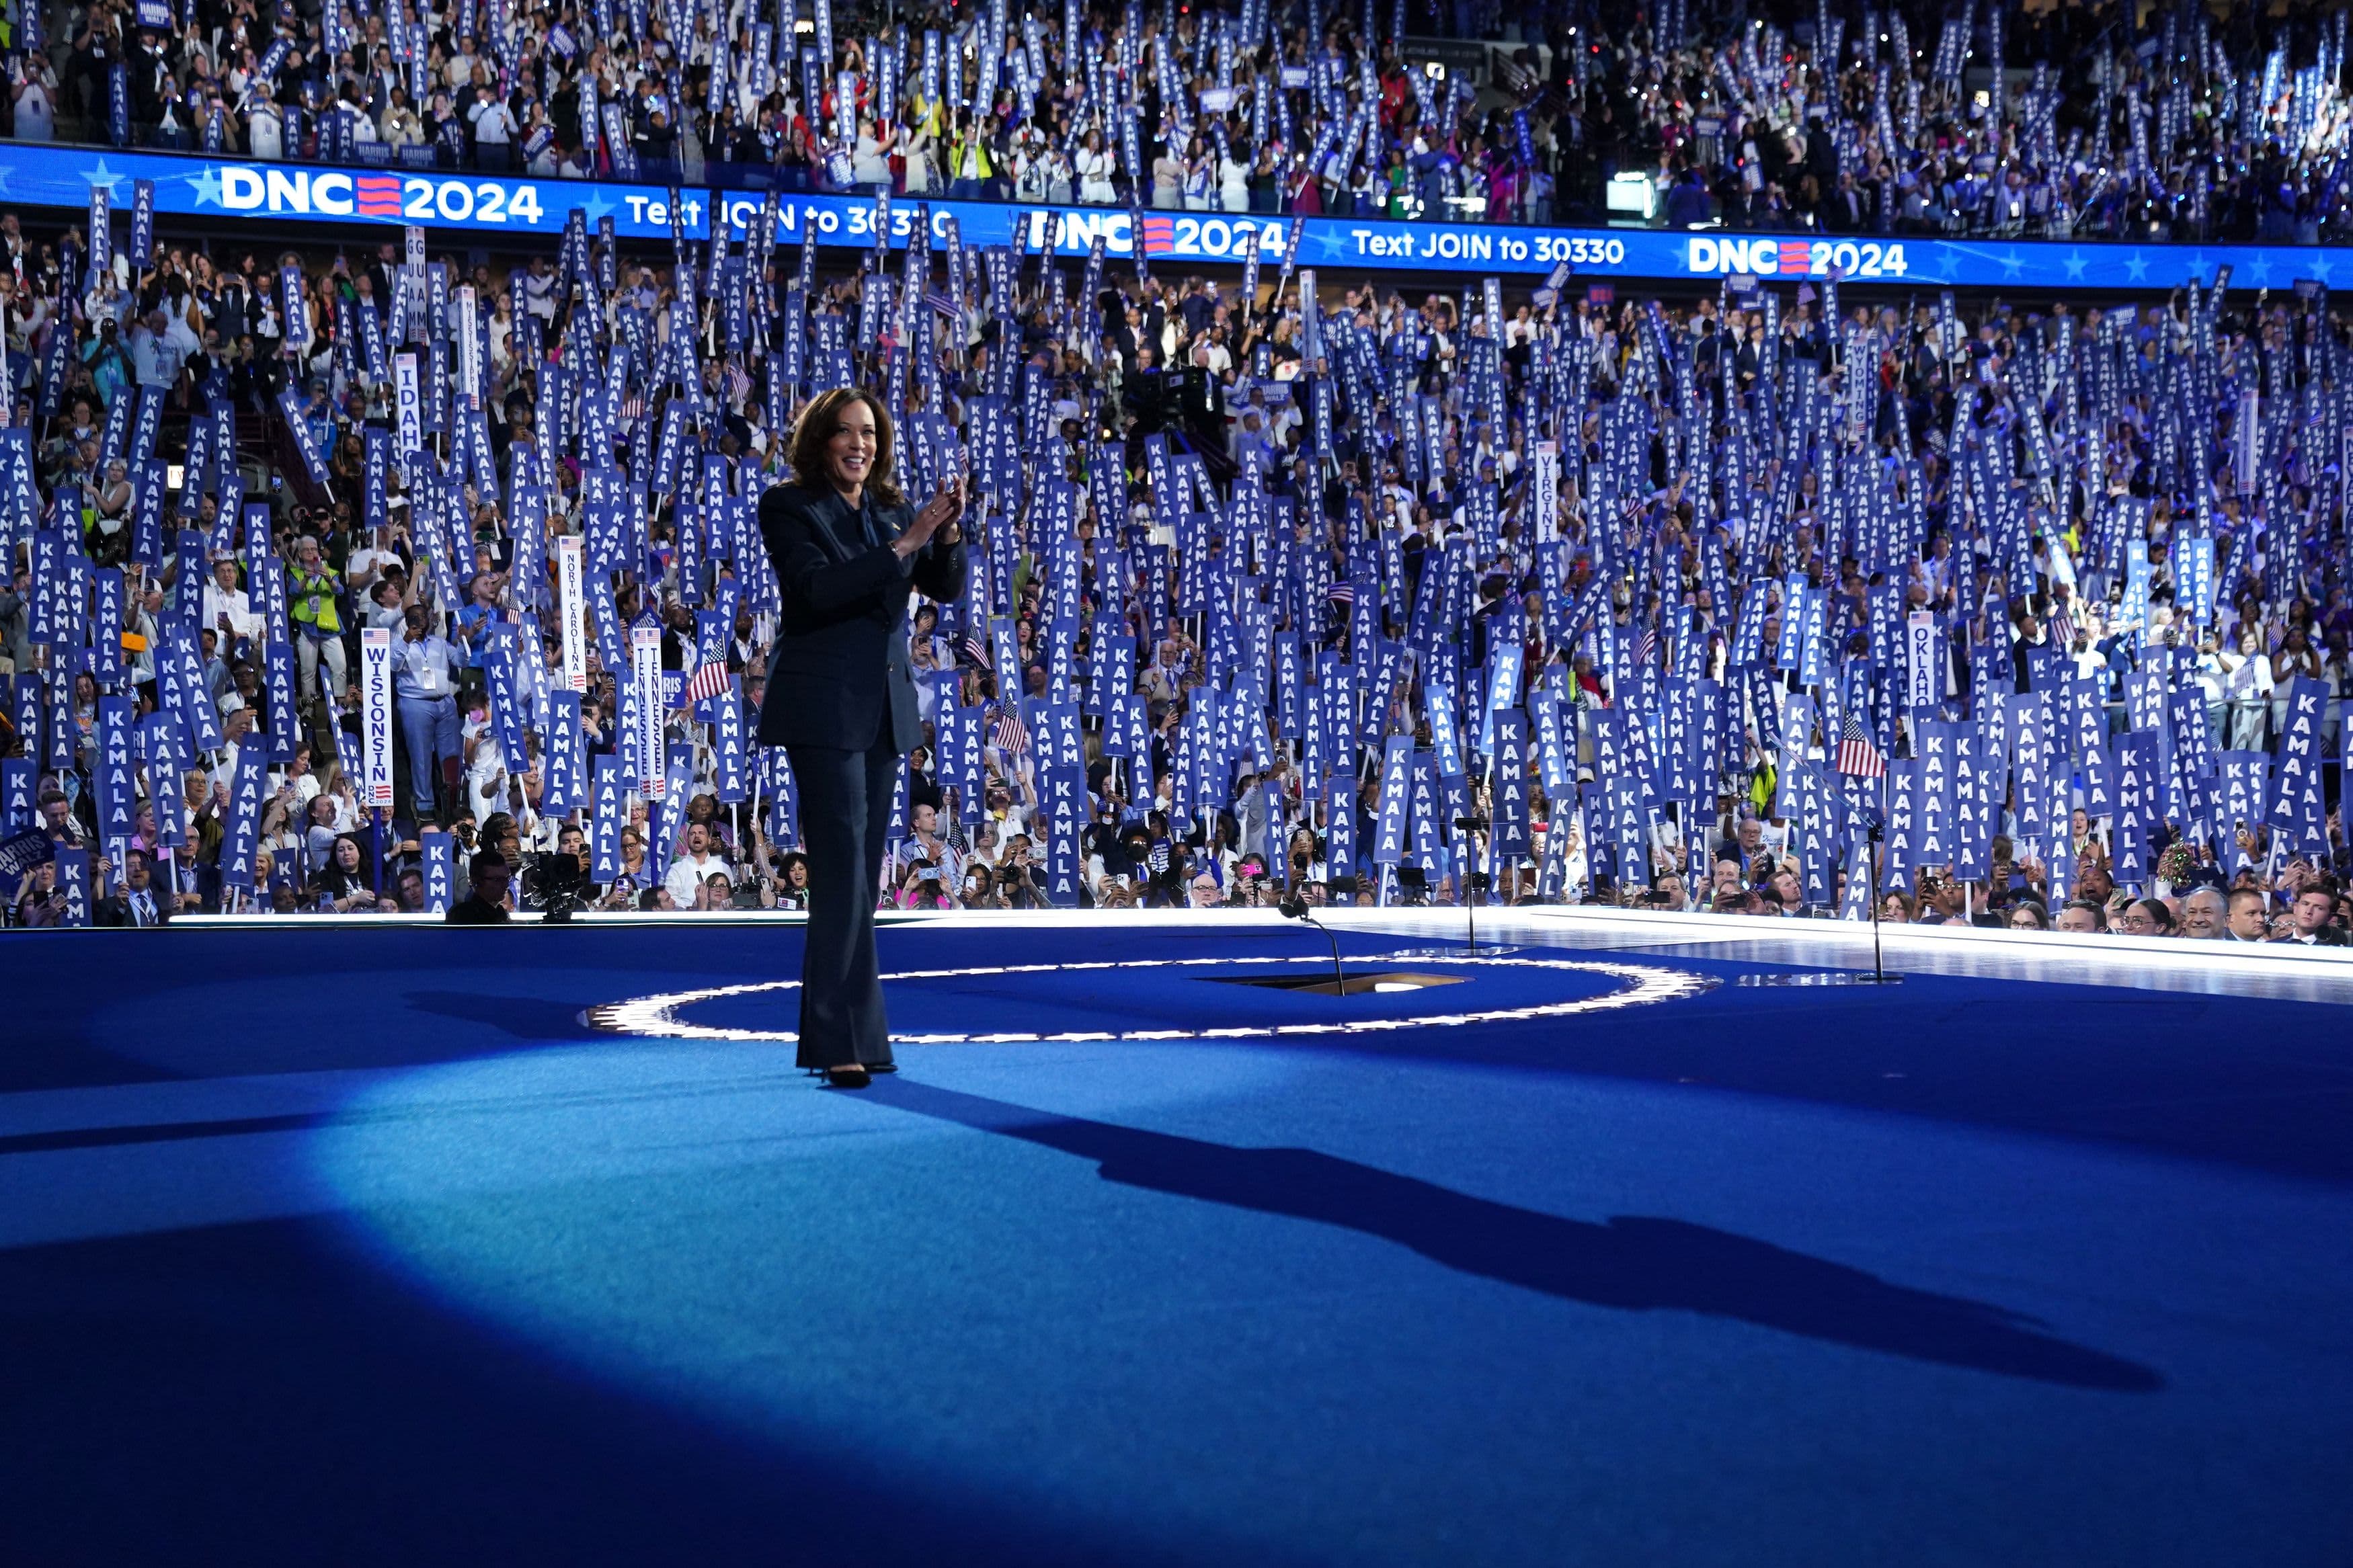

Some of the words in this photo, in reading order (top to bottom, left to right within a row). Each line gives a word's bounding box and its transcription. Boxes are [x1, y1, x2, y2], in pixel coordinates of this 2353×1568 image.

[95, 194, 104, 261] KAMALA
[135, 188, 148, 258] KAMALA
[221, 166, 352, 214] DNC
[405, 179, 543, 224] 2024
[573, 215, 586, 270] KAMALA
[1031, 211, 1133, 252] DNC
[1174, 218, 1287, 257] 2024
[1041, 217, 1056, 274] KAMALA
[1246, 237, 1257, 294] KAMALA
[1284, 216, 1302, 270] KAMALA
[1351, 229, 1414, 255] Text
[1421, 233, 1491, 259] JOIN
[1499, 236, 1527, 261] to
[1534, 237, 1624, 264] 30330
[1689, 238, 1778, 274] DNC
[1811, 242, 1907, 276] 2024
[286, 274, 301, 335] KAMALA
[407, 239, 415, 325] GUAM
[416, 240, 426, 324] GUAM
[432, 272, 442, 339] KAMALA
[731, 275, 740, 343] KAMALA
[909, 263, 918, 324] KAMALA
[998, 253, 1006, 313] KAMALA
[1826, 286, 1837, 338] KAMALA
[45, 335, 66, 408] KAMALA
[435, 352, 444, 423] KAMALA
[770, 362, 779, 429] KAMALA
[1725, 357, 1735, 419] KAMALA
[1854, 345, 1866, 421] WYOMING
[134, 394, 157, 473] KAMALA
[286, 401, 323, 473] KAMALA
[559, 378, 571, 446] KAMALA
[657, 411, 680, 484] KAMALA
[982, 408, 997, 483] KAMALA
[1034, 388, 1049, 454] KAMALA
[1319, 388, 1327, 450] KAMALA
[1406, 410, 1419, 473] KAMALA
[1428, 405, 1441, 469] KAMALA
[1567, 405, 1578, 467] KAMALA
[1952, 393, 1971, 452] KAMALA
[2028, 407, 2050, 470] KAMALA
[11, 439, 31, 526] KAMALA
[184, 426, 206, 508] KAMALA
[372, 438, 381, 517] KAMALA
[472, 422, 492, 491] KAMALA
[895, 421, 909, 491] KAMALA
[915, 421, 934, 492] KAMALA
[1151, 444, 1171, 517] KAMALA
[1971, 461, 1989, 527] KAMALA
[2090, 429, 2101, 493] KAMALA
[139, 470, 160, 554] KAMALA
[709, 466, 722, 549] KAMALA
[1696, 461, 1709, 528] KAMALA
[1912, 470, 1923, 534] KAMALA
[424, 519, 456, 601] KAMALA
[516, 515, 532, 592] KAMALA
[567, 554, 575, 596] NORTH
[682, 514, 696, 593] KAMALA
[994, 527, 1008, 604] KAMALA
[1389, 540, 1402, 614] KAMALA
[1544, 552, 1560, 626] KAMALA
[1708, 544, 1728, 617] KAMALA
[1959, 540, 1973, 610] KAMALA
[2017, 517, 2032, 586] KAMALA
[2180, 528, 2190, 597] KAMALA
[2195, 547, 2208, 618] KAMALA
[2221, 533, 2247, 600] KAMALA
[102, 581, 116, 671] KAMALA
[594, 581, 621, 663] KAMALA
[1154, 556, 1164, 630] KAMALA
[1209, 572, 1238, 655] KAMALA
[1305, 556, 1317, 631] KAMALA
[1414, 561, 1438, 640] KAMALA
[1665, 554, 1677, 628] KAMALA
[1782, 583, 1802, 660] KAMALA
[570, 603, 580, 670] CAROLINA
[1357, 595, 1370, 678] KAMALA
[1915, 628, 1928, 705] OKLAHO
[55, 655, 67, 756] KAMALA
[273, 658, 290, 751] KAMALA
[366, 649, 387, 781] WISCONSIN
[623, 682, 637, 777] KAMALA
[637, 649, 648, 774] TENNESSEE
[651, 648, 662, 774] TENNESSEE
[721, 688, 740, 789] KAMALA
[941, 684, 954, 774] KAMALA
[1307, 697, 1319, 788] KAMALA
[1670, 690, 1683, 789] KAMALA
[108, 711, 128, 823] KAMALA
[153, 727, 177, 833] KAMALA
[550, 704, 571, 804] KAMALA
[965, 720, 978, 813] KAMALA
[1130, 708, 1150, 798] KAMALA
[1196, 699, 1212, 793] KAMALA
[1501, 725, 1521, 840] KAMALA
[1538, 702, 1561, 788] KAMALA
[1624, 695, 1654, 796] KAMALA
[1702, 695, 1715, 811] KAMALA
[2019, 709, 2038, 823] KAMALA
[2077, 693, 2107, 803] KAMALA
[2175, 706, 2201, 807] KAMALA
[2275, 694, 2317, 816] KAMALA
[232, 765, 259, 872] KAMALA
[598, 769, 615, 870] KAMALA
[1382, 750, 1405, 850] KAMALA
[1415, 767, 1434, 869] KAMALA
[1802, 776, 1823, 889] KAMALA
[1890, 775, 1911, 886] KAMALA
[1924, 738, 1943, 852] KAMALA
[1957, 739, 1974, 864] KAMALA
[2121, 751, 2140, 868] KAMALA
[1055, 782, 1072, 893] KAMALA
